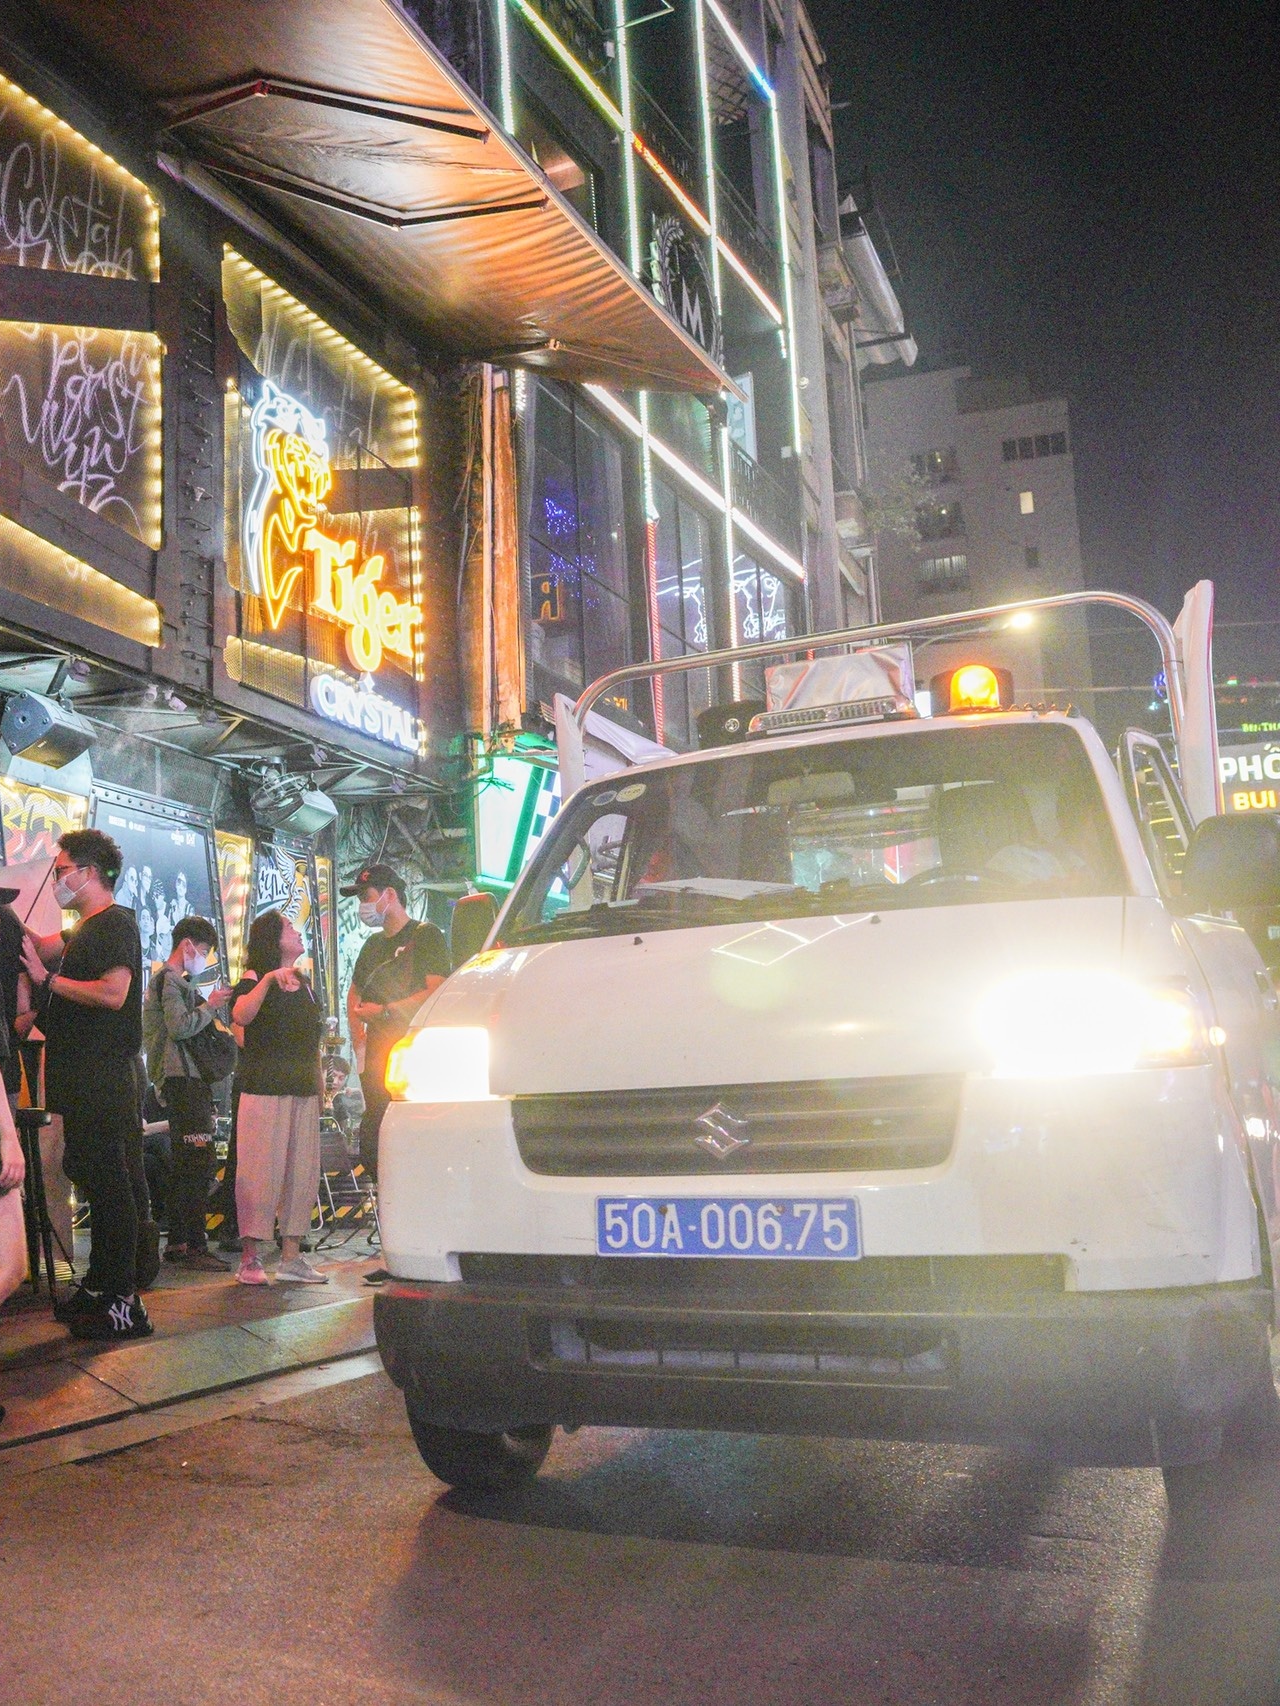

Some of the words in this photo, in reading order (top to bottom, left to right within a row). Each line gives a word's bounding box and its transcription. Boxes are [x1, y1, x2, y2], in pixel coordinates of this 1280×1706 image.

[304, 527, 422, 673] Tiger
[309, 674, 422, 751] CRYSTAL
[603, 1202, 849, 1252] 50A-006.75
